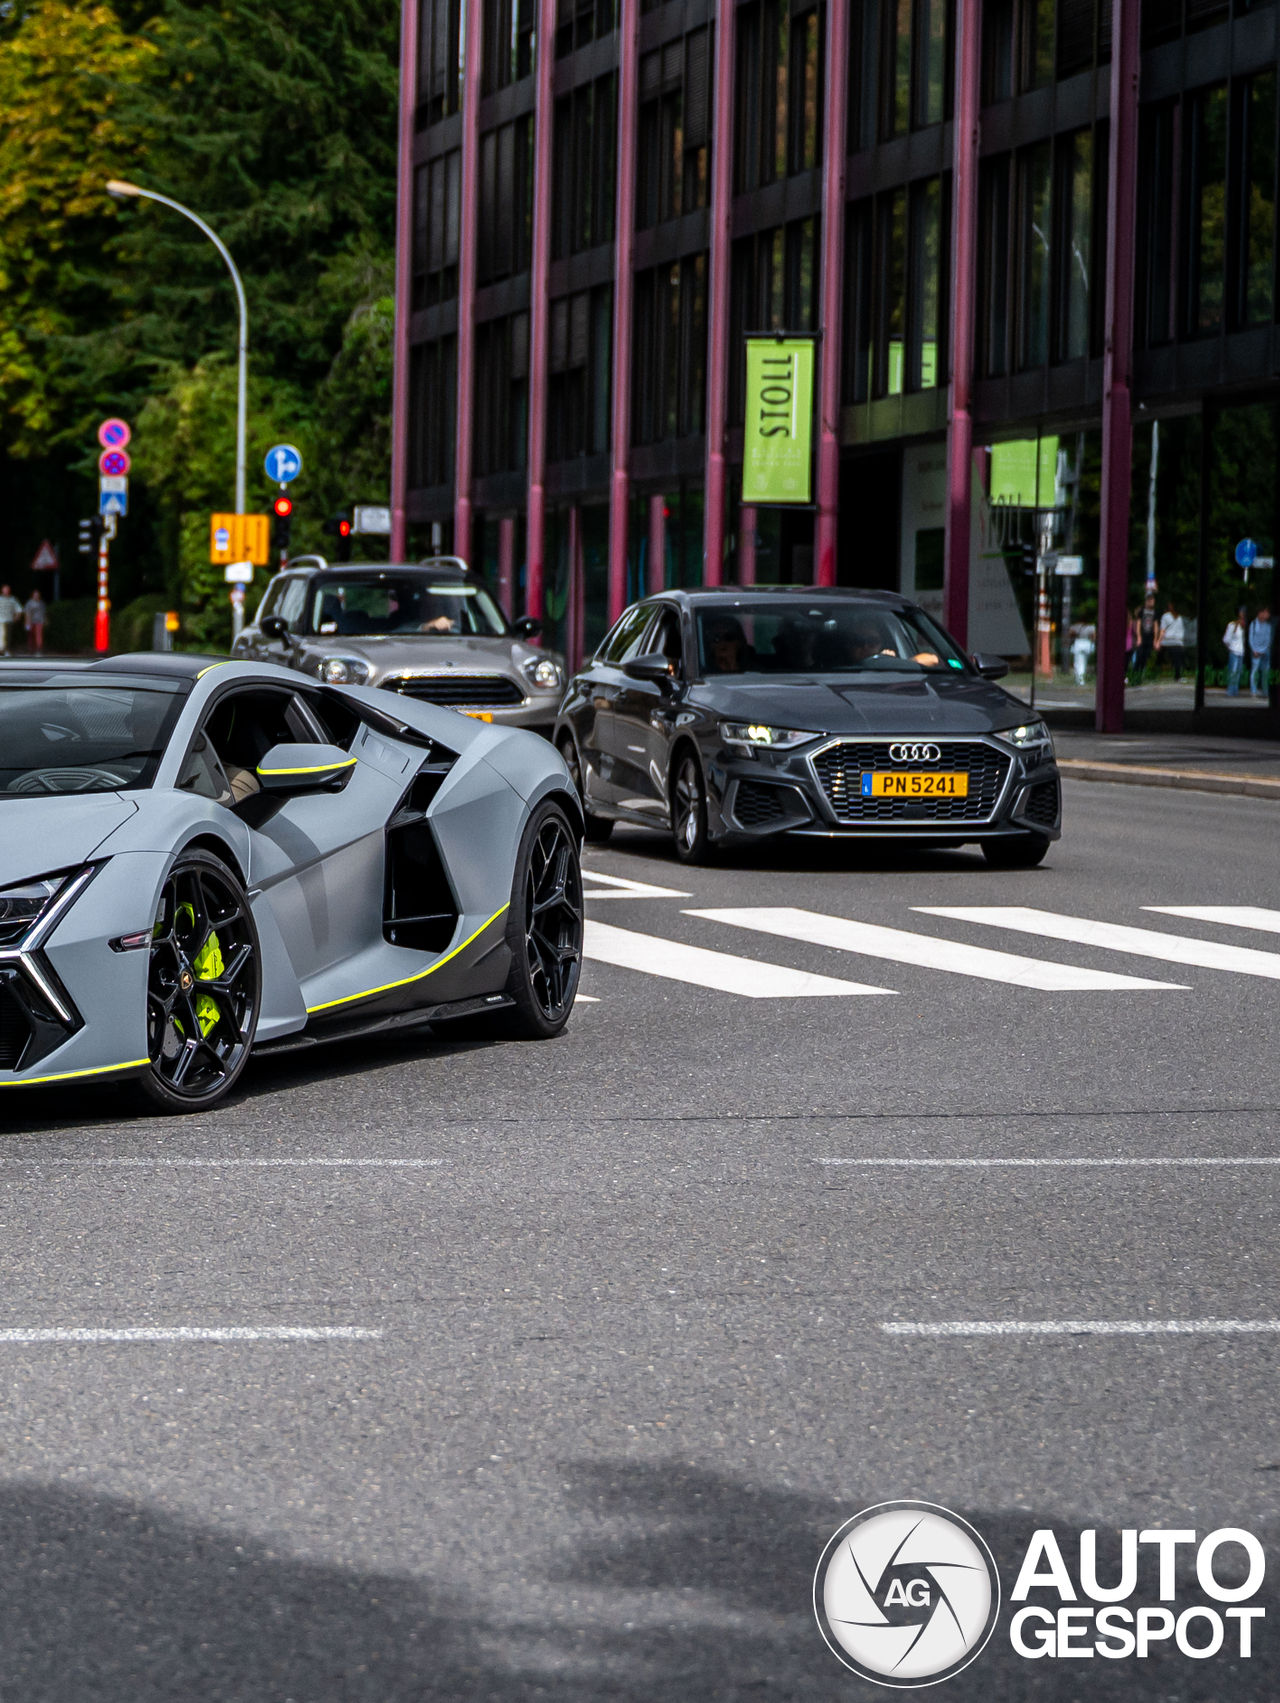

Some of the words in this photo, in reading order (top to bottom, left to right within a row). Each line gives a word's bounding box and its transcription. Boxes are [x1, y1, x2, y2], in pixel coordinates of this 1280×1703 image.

[759, 354, 792, 438] STOLL
[883, 776, 907, 793] PN
[911, 776, 955, 794] 5241
